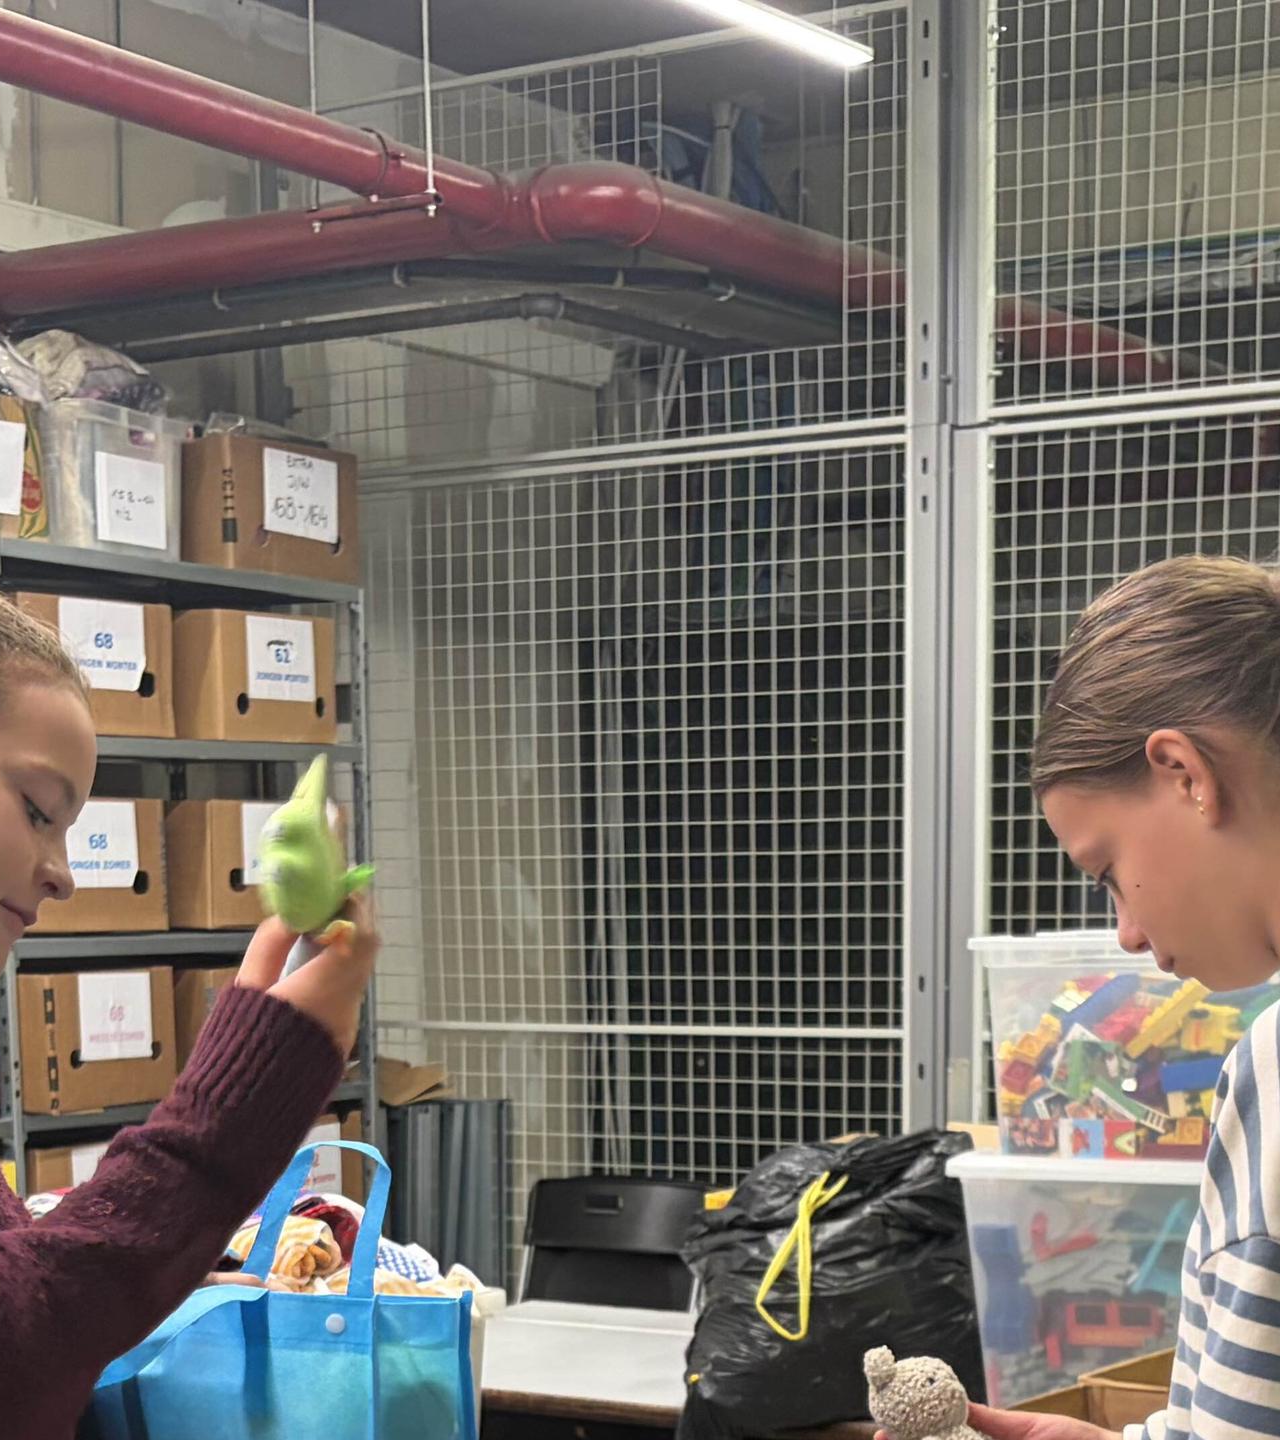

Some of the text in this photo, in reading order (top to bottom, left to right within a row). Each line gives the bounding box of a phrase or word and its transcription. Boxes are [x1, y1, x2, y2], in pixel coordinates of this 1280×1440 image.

[94, 632, 114, 649] 68
[89, 834, 108, 850] 68
[70, 860, 102, 871] ONGEN
